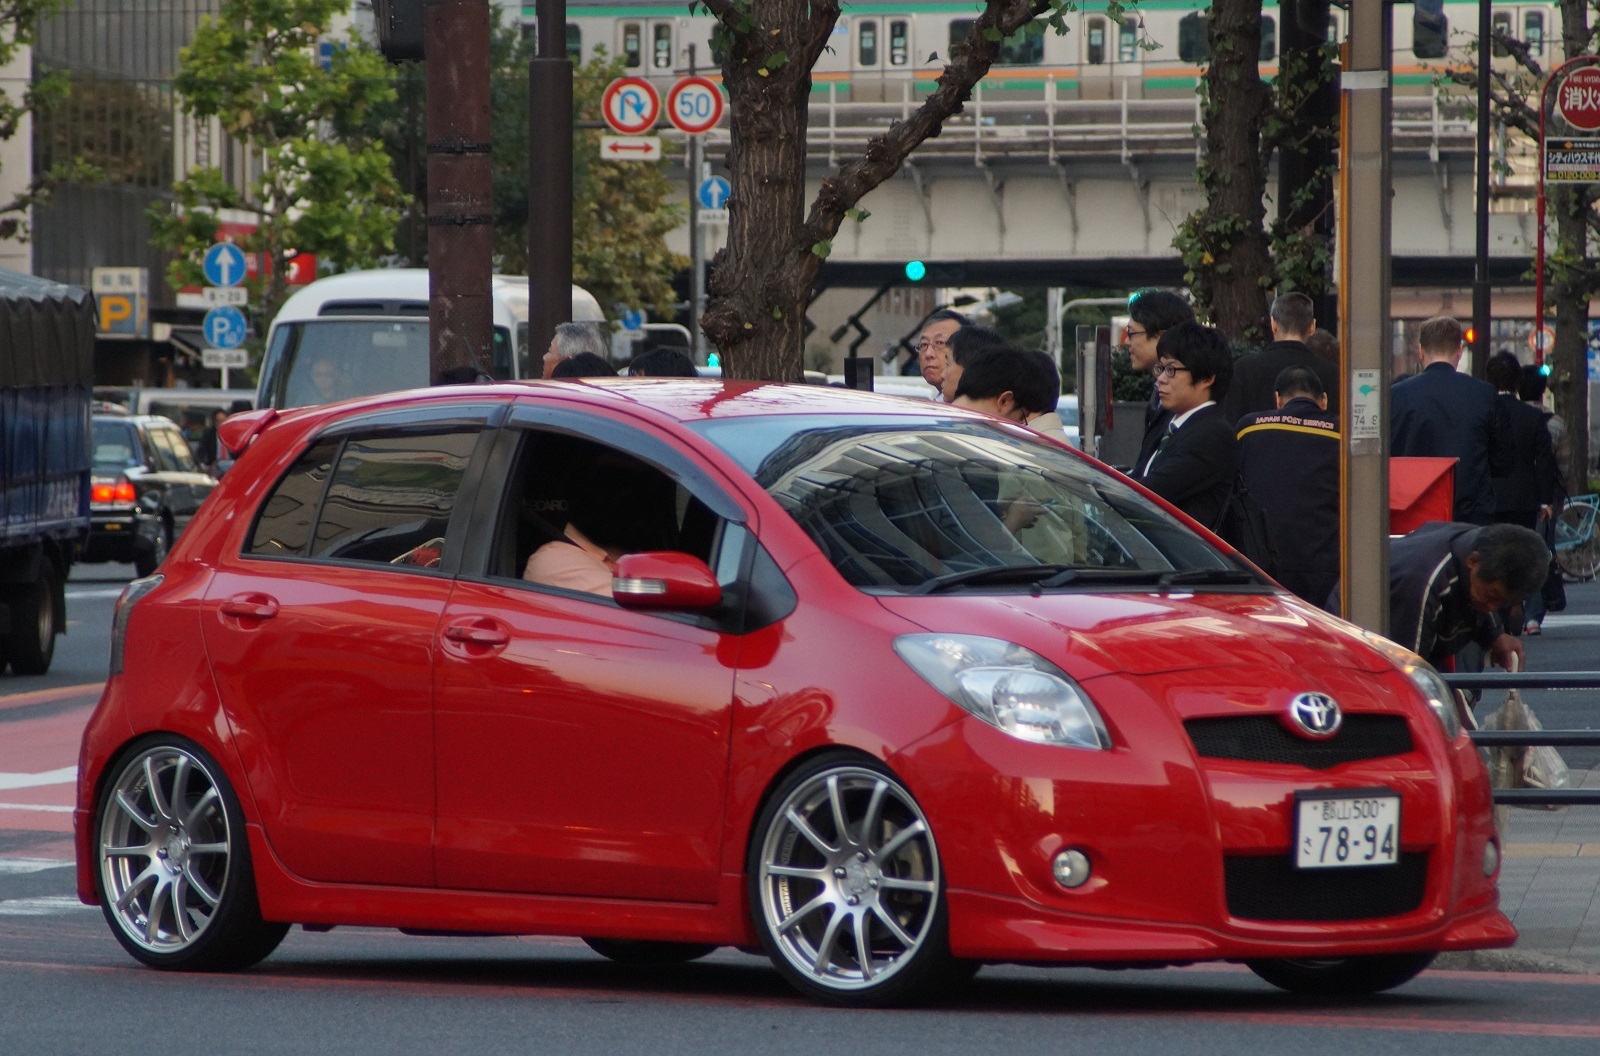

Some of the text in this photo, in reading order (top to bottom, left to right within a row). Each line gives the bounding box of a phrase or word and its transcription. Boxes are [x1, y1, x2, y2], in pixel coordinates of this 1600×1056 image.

[679, 92, 711, 118] 50
[1564, 86, 1600, 111] 消火
[101, 295, 132, 333] P
[212, 316, 231, 345] P
[1255, 415, 1335, 430] JAPAN POST SERVICE
[1354, 415, 1365, 425] 74
[1317, 823, 1394, 863] 78-94
